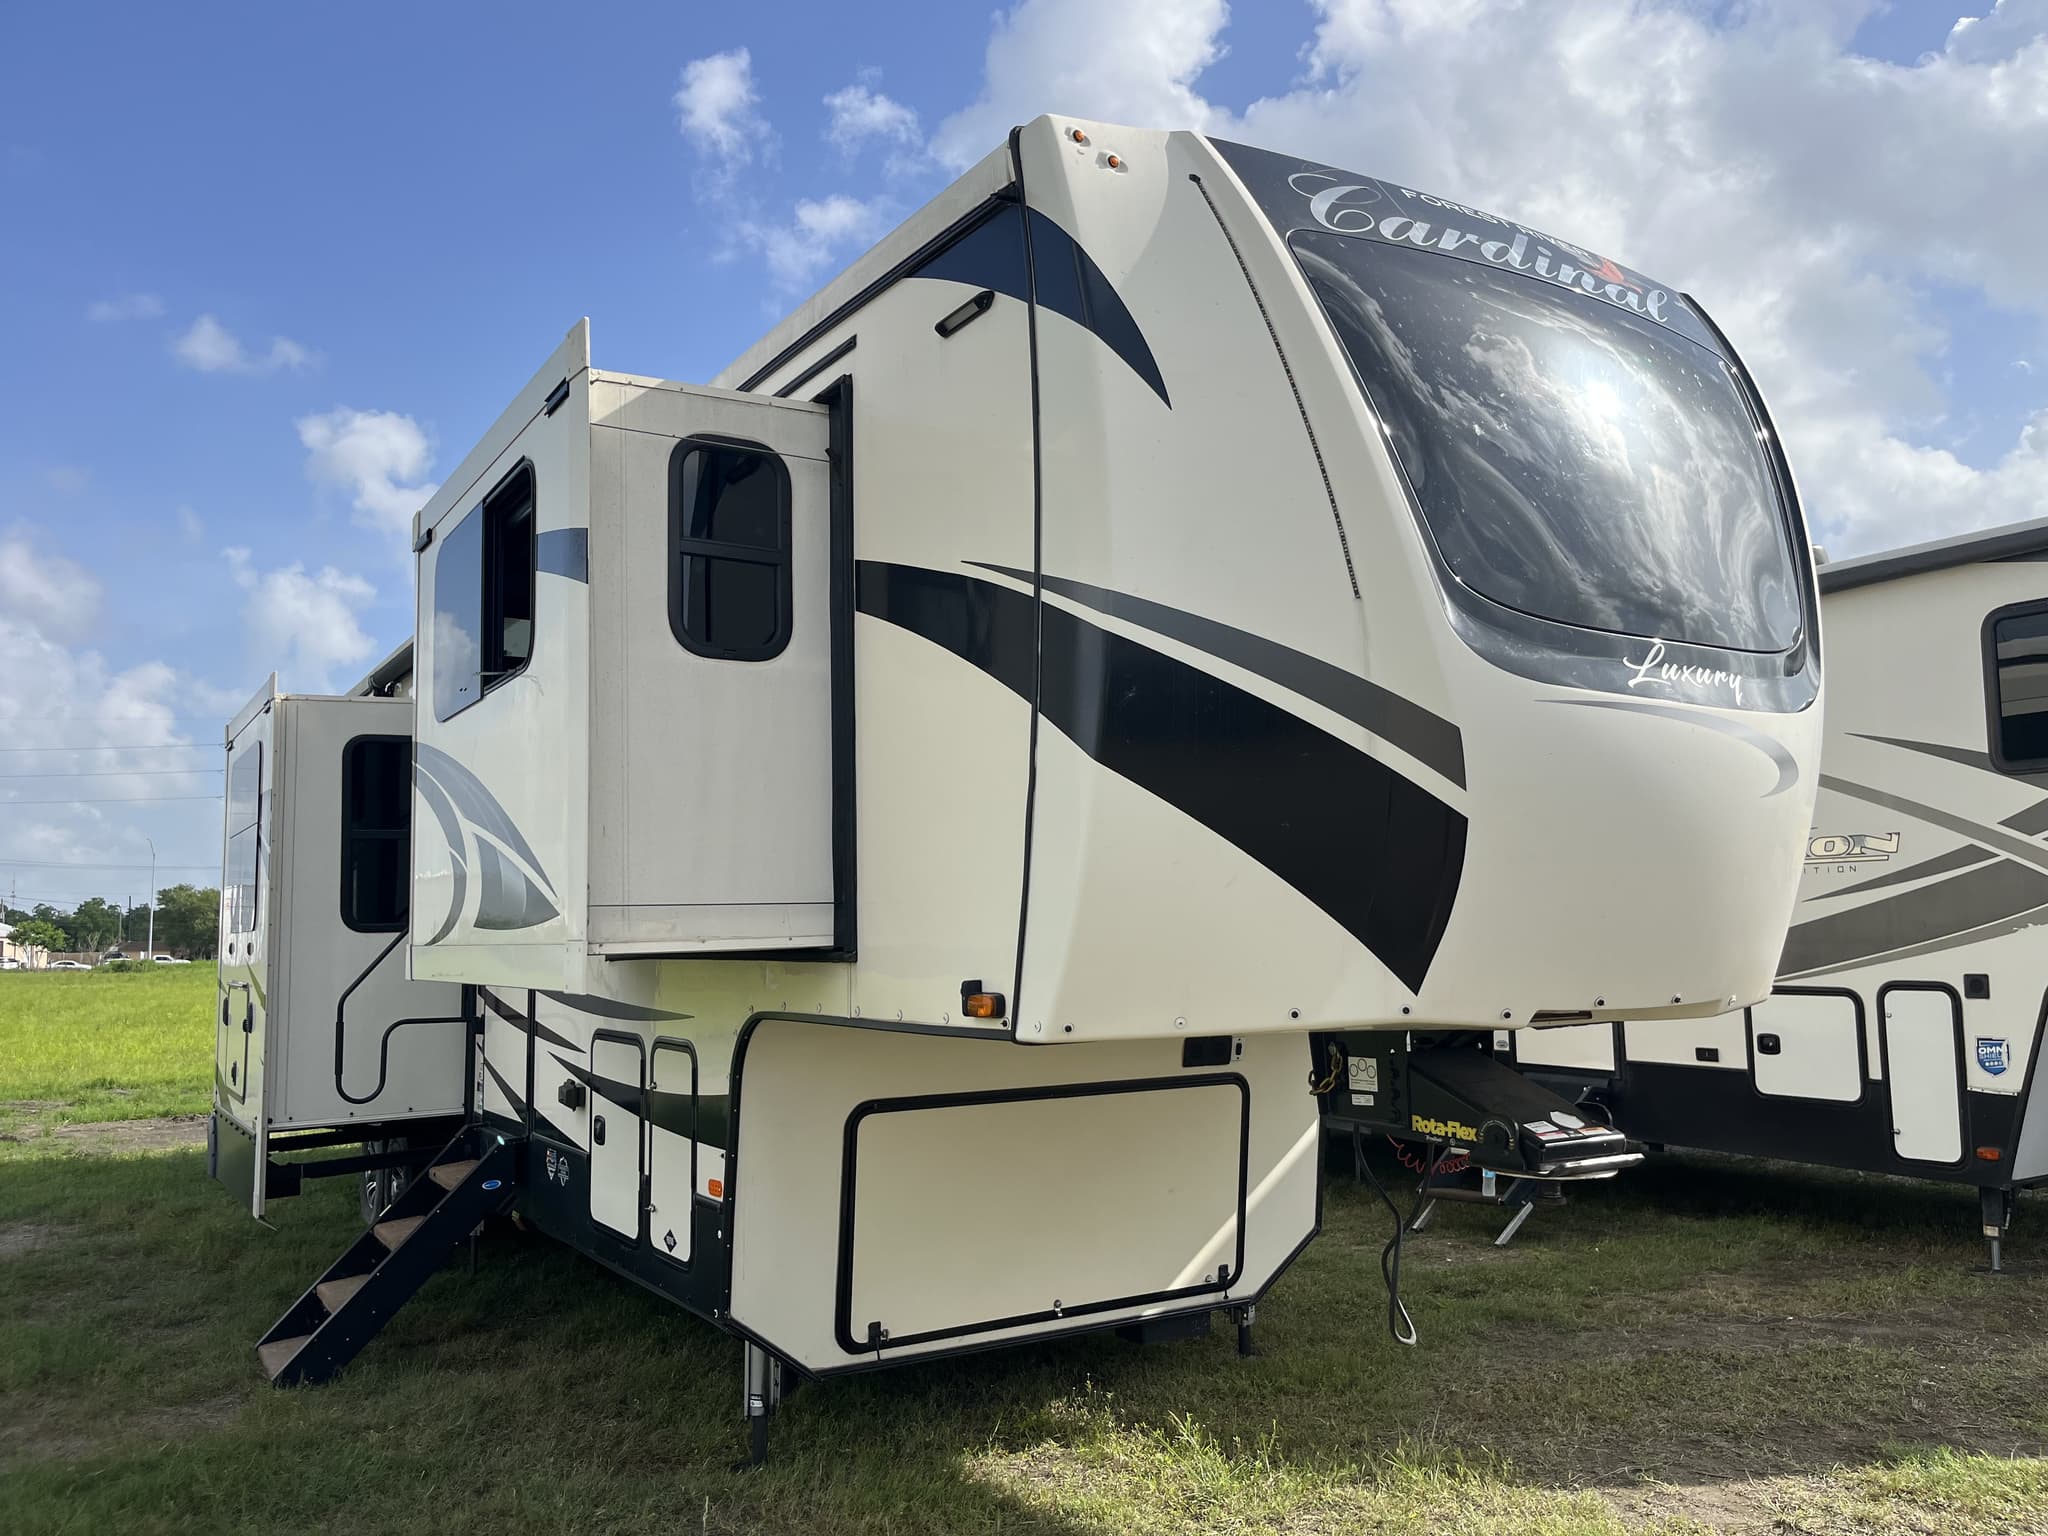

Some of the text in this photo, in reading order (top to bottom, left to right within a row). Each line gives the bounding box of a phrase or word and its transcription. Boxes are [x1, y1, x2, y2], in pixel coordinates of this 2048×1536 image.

[1287, 173, 1668, 322] Cardinal
[1622, 643, 1743, 706] Luxury
[1806, 832, 1900, 857] ON
[1411, 1114, 1478, 1142] Rota-Flex
